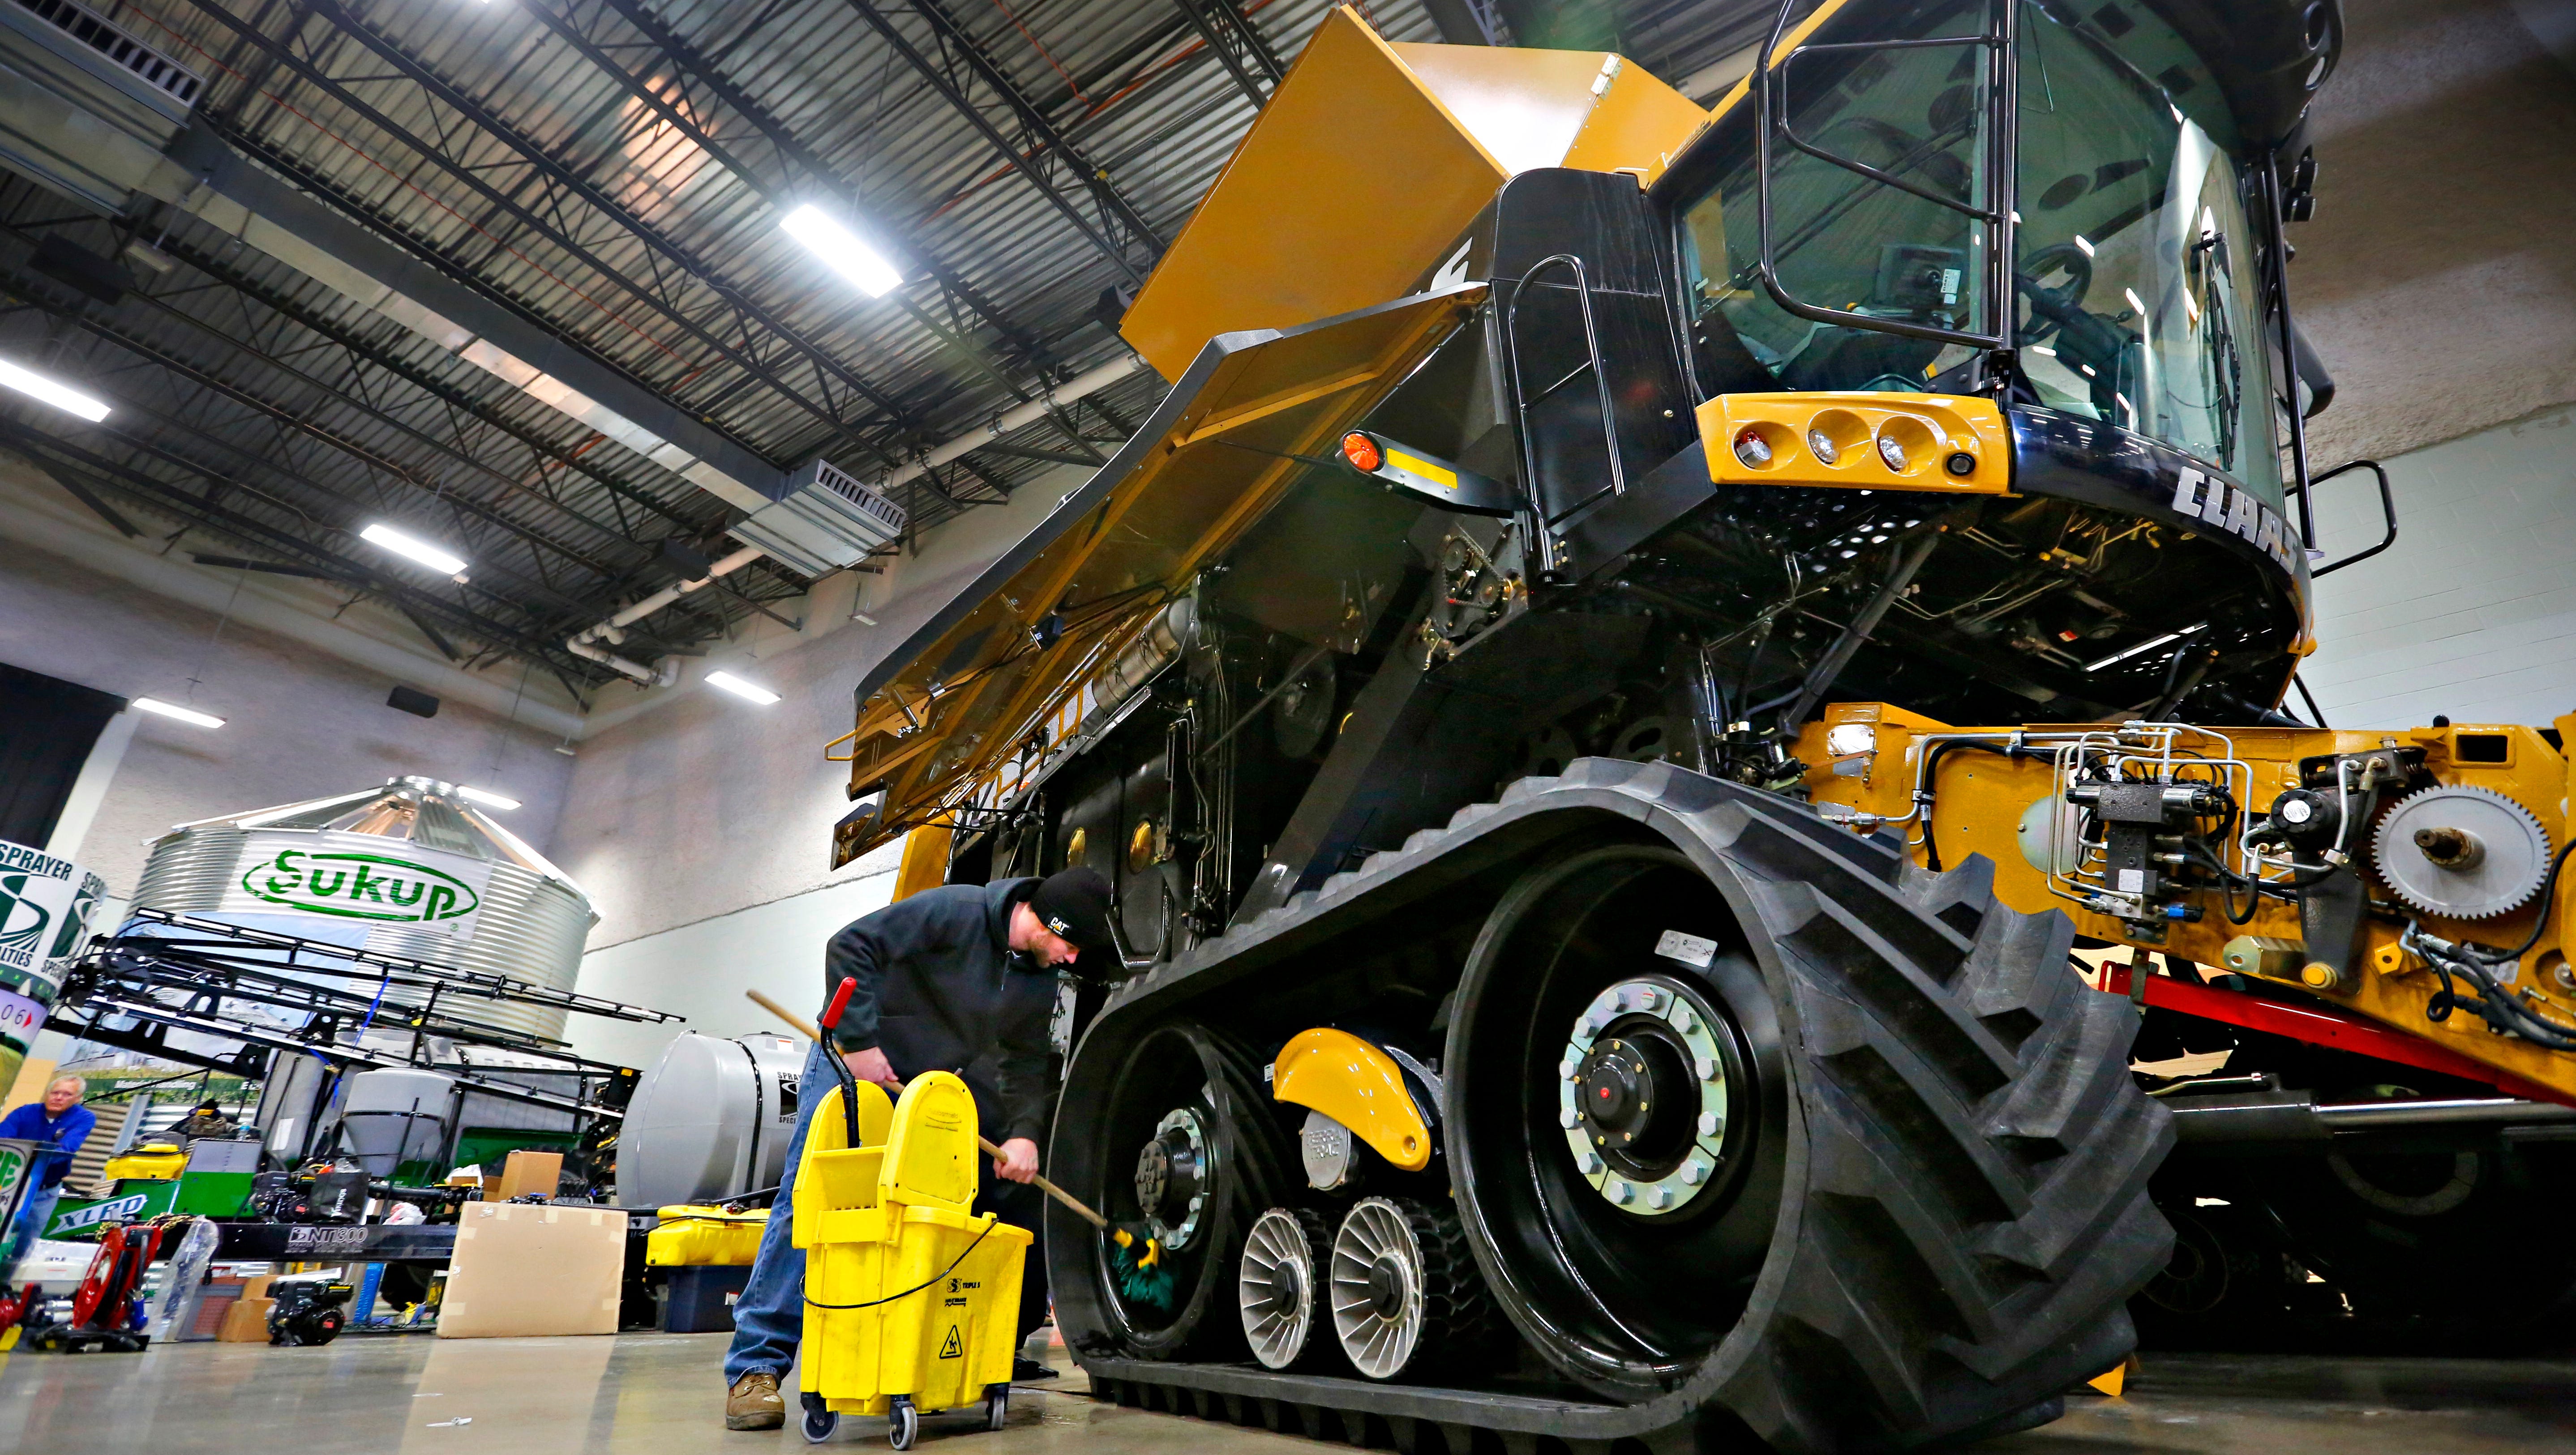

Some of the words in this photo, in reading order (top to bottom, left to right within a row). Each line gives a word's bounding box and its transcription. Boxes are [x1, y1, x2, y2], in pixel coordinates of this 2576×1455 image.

[2173, 466, 2297, 575] CLAAS
[0, 843, 73, 881] SPRAYER
[266, 849, 456, 921] Sukup
[1050, 917, 1067, 932] CAT
[0, 946, 32, 967] LTIES
